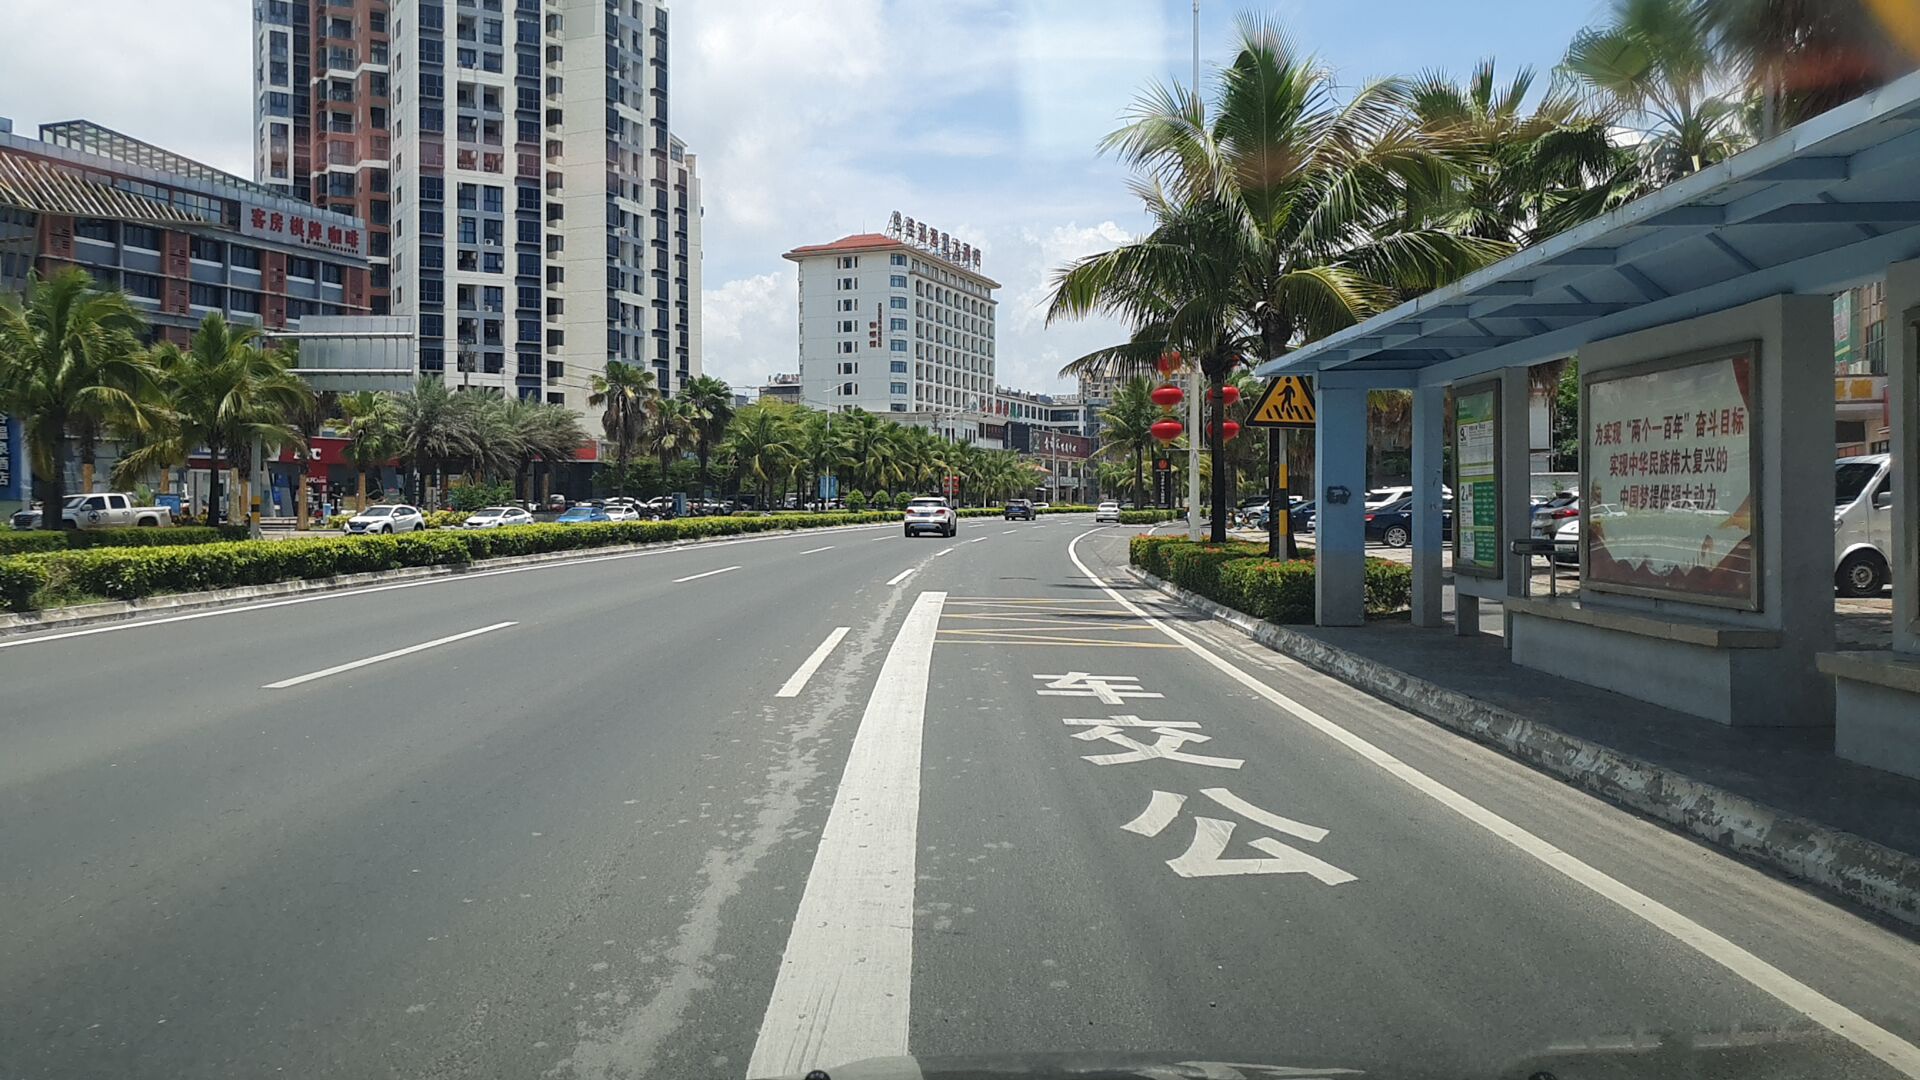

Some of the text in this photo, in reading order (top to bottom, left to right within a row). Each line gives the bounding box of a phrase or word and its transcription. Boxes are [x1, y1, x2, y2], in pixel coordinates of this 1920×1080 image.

[251, 208, 284, 233] 客房
[290, 215, 322, 241] 棋牌
[328, 226, 360, 249] 咖啡
[1609, 446, 1728, 477] 实现中华民族伟大复兴的
[1620, 483, 1717, 510] 中国梦提供强大动力
